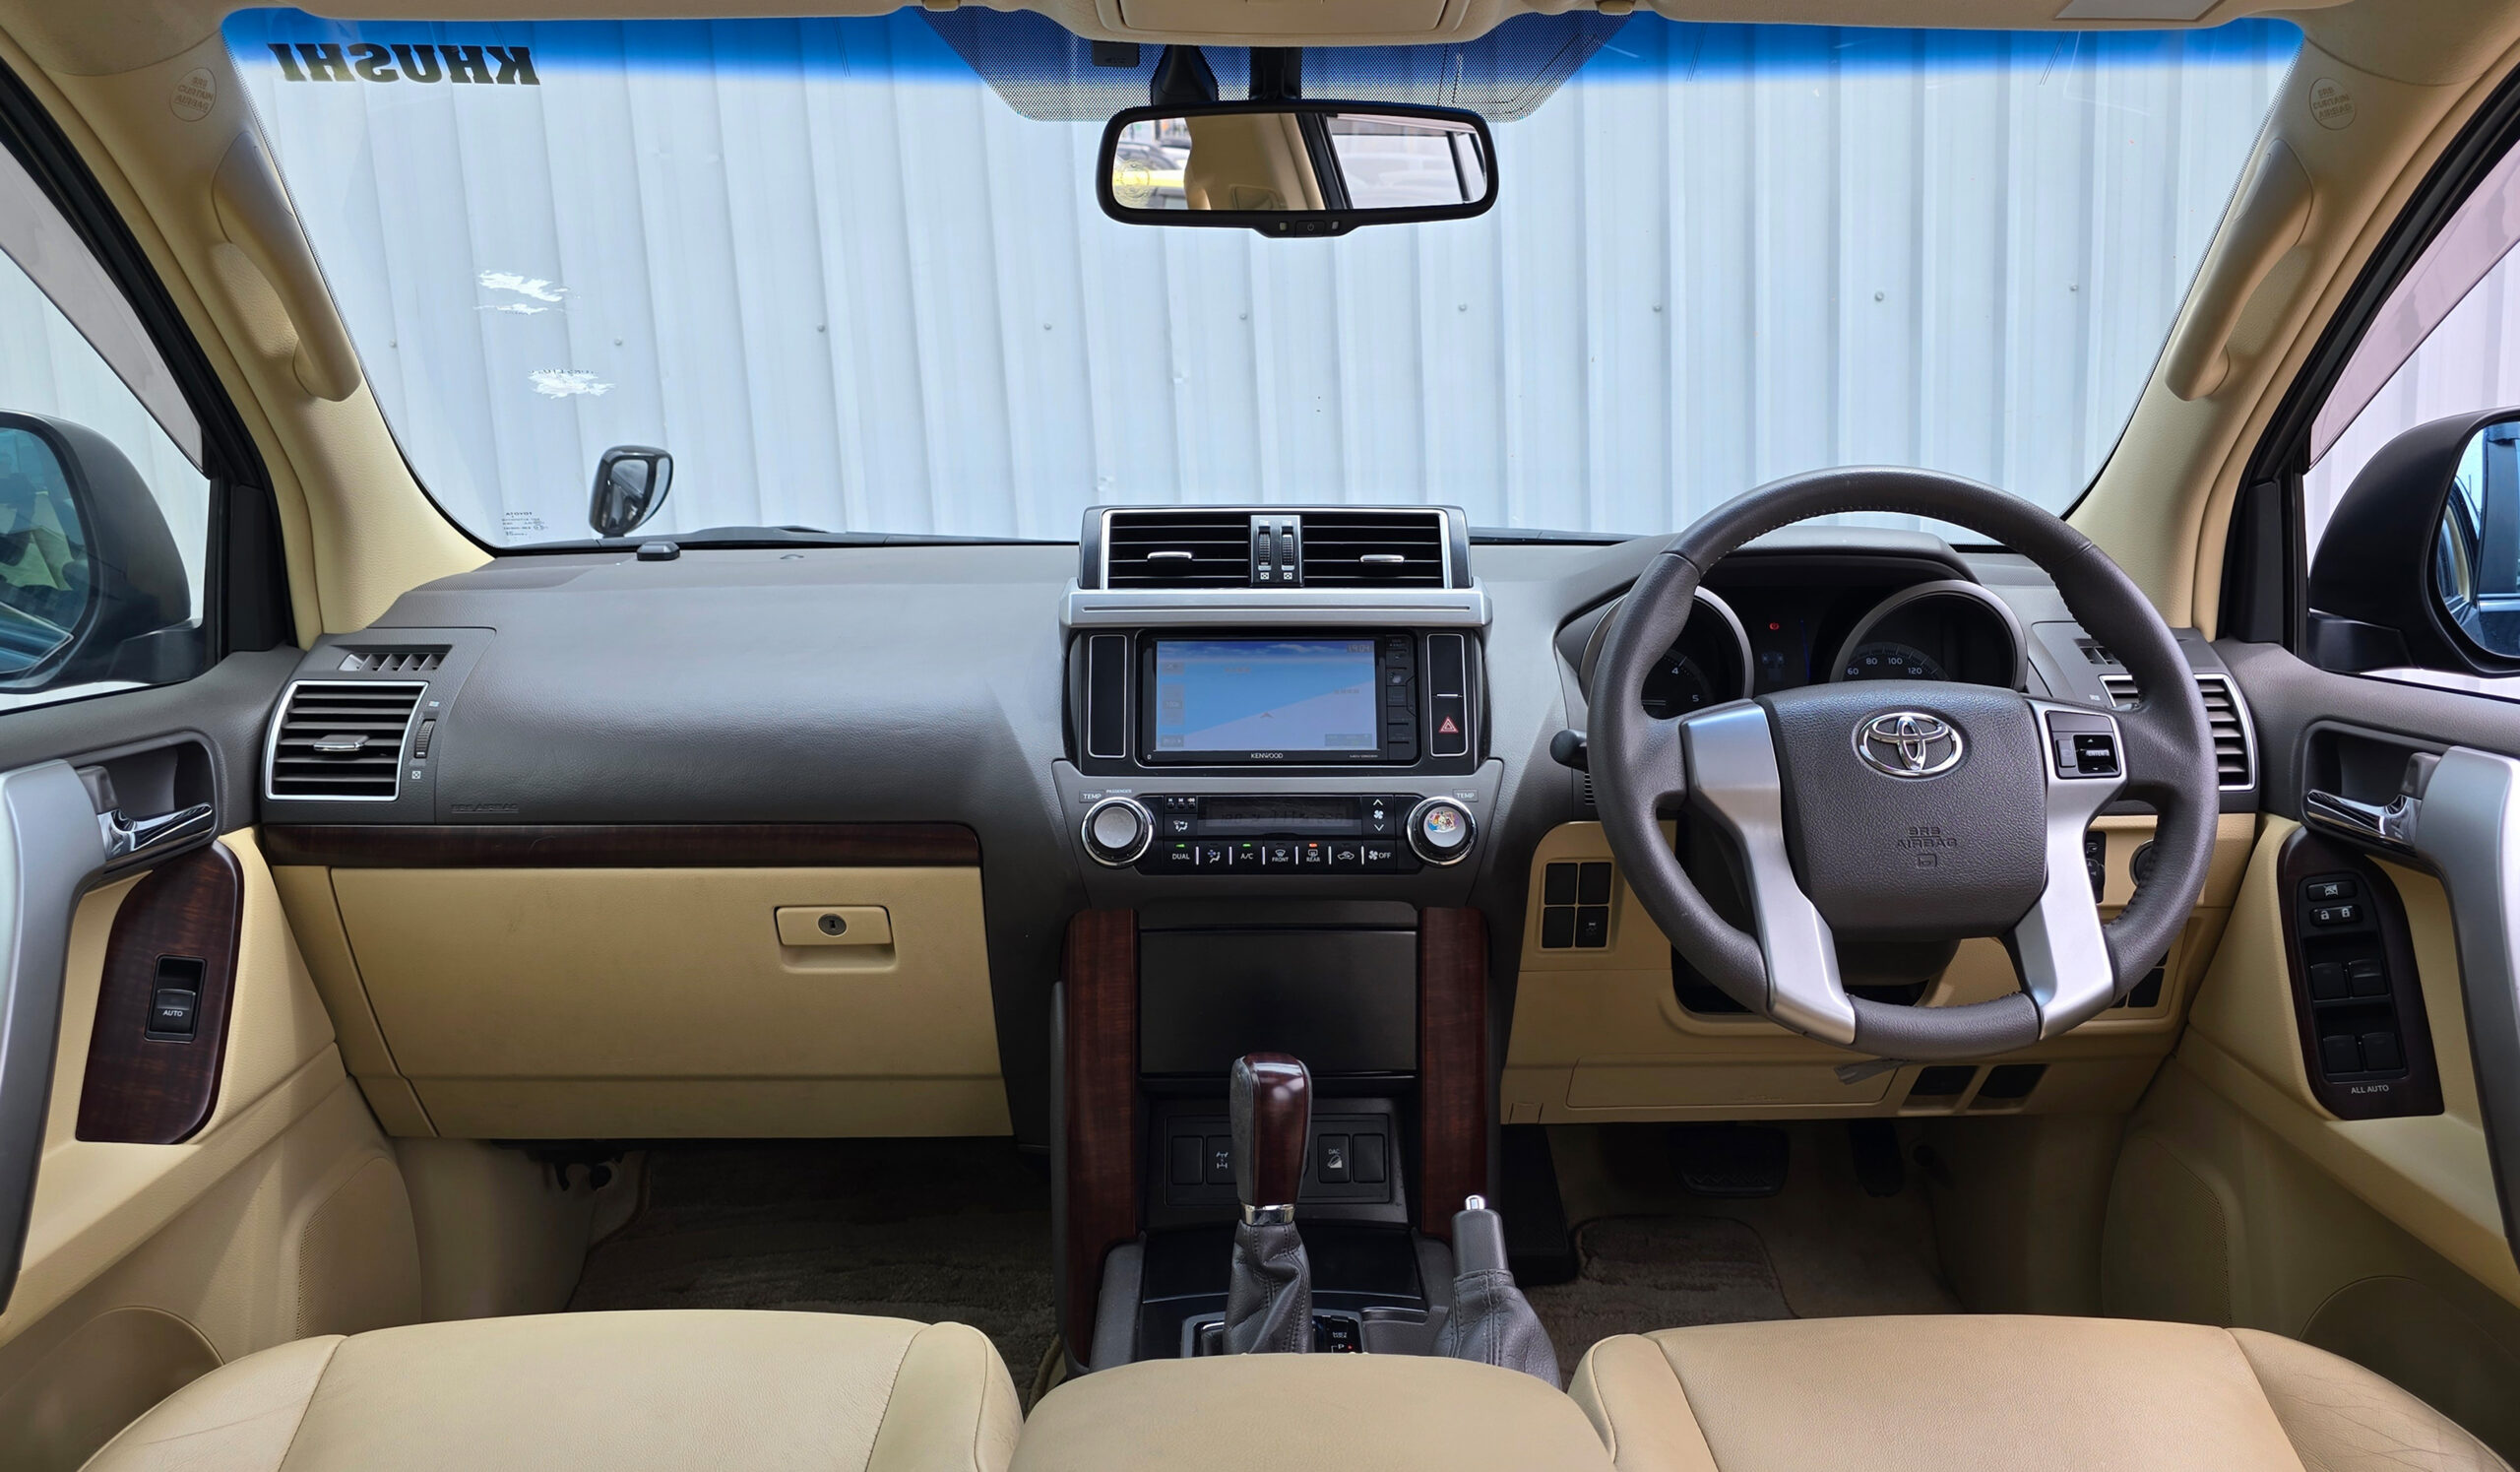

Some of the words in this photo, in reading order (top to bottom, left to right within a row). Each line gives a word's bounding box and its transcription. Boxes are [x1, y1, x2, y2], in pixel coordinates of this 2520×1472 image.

[1865, 657, 1878, 666] 80
[1888, 657, 1903, 666] 100
[1908, 667, 1922, 675] 120
[1250, 751, 1284, 760] KENWOOD
[1897, 838, 1957, 848] AIRBAG
[2366, 1084, 2390, 1093] AUTO
